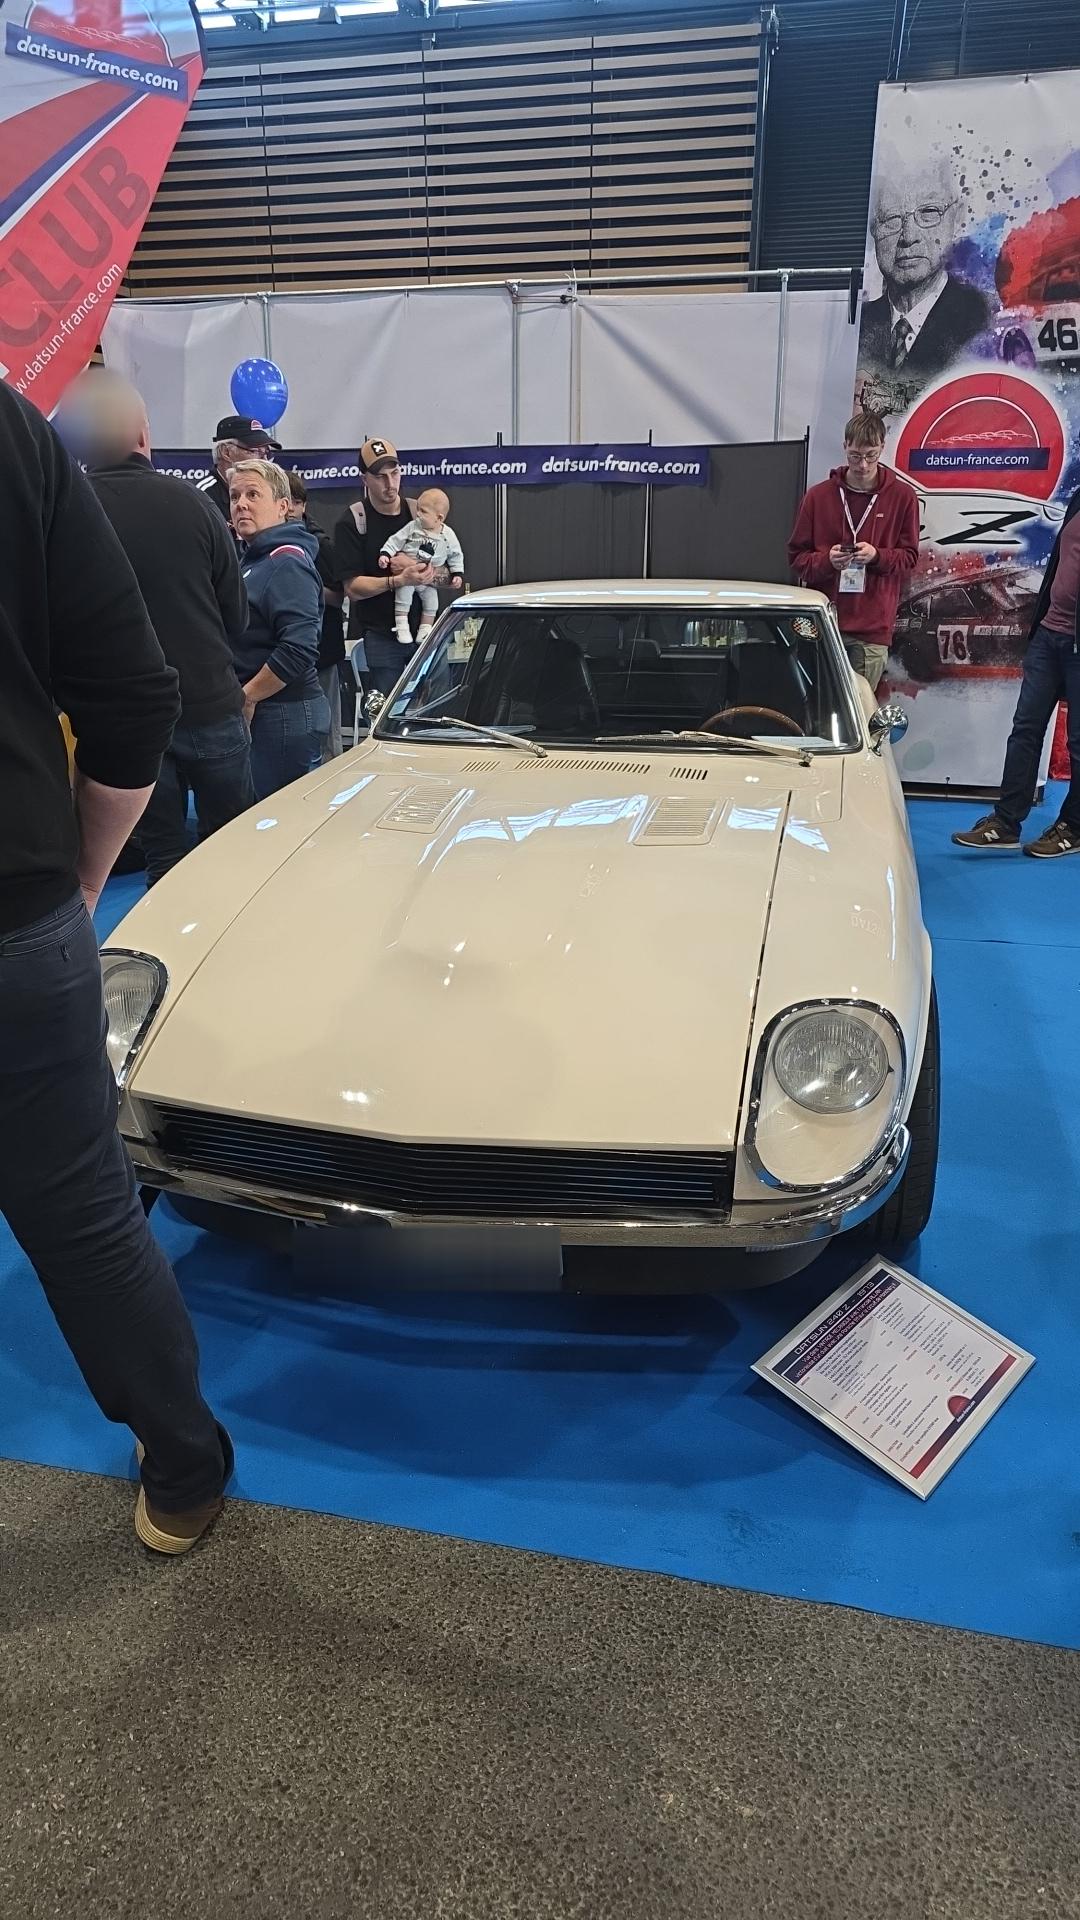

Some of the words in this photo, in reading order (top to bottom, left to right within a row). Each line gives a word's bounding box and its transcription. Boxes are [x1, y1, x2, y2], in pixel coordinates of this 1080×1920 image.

[16, 35, 179, 91] datsun-france.com
[0, 146, 151, 347] CLUB
[1037, 317, 1079, 351] 46
[399, 458, 528, 476] atsun-france.com
[541, 454, 700, 475] datsun-france.com
[925, 453, 1030, 467] datsun-france.com
[935, 510, 1039, 546] Z
[939, 630, 967, 660] 76
[793, 1323, 828, 1355] DATSUN
[825, 1309, 844, 1325] 240
[855, 1281, 875, 1297] 1973
